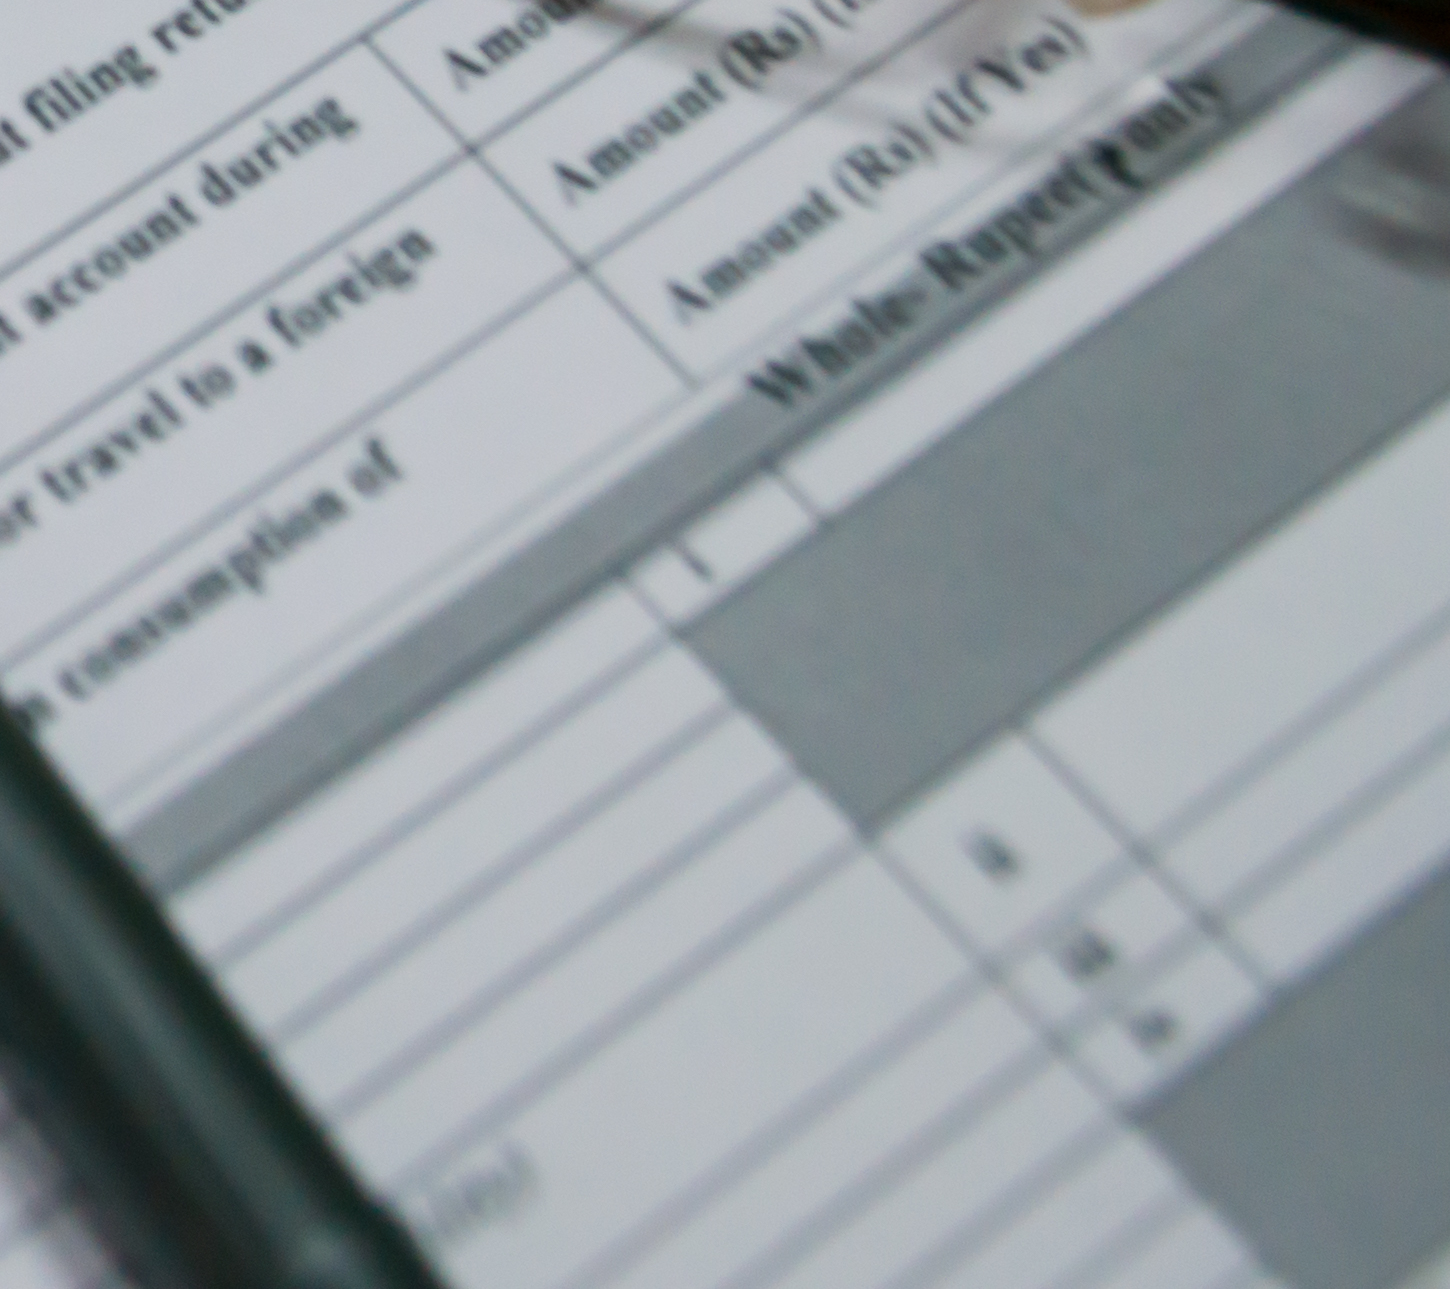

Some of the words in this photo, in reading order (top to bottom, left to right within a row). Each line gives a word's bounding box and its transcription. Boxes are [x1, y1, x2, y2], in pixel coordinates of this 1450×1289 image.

[20, 189, 202, 329] account
[195, 93, 362, 210] during
[662, 184, 845, 324] Amount
